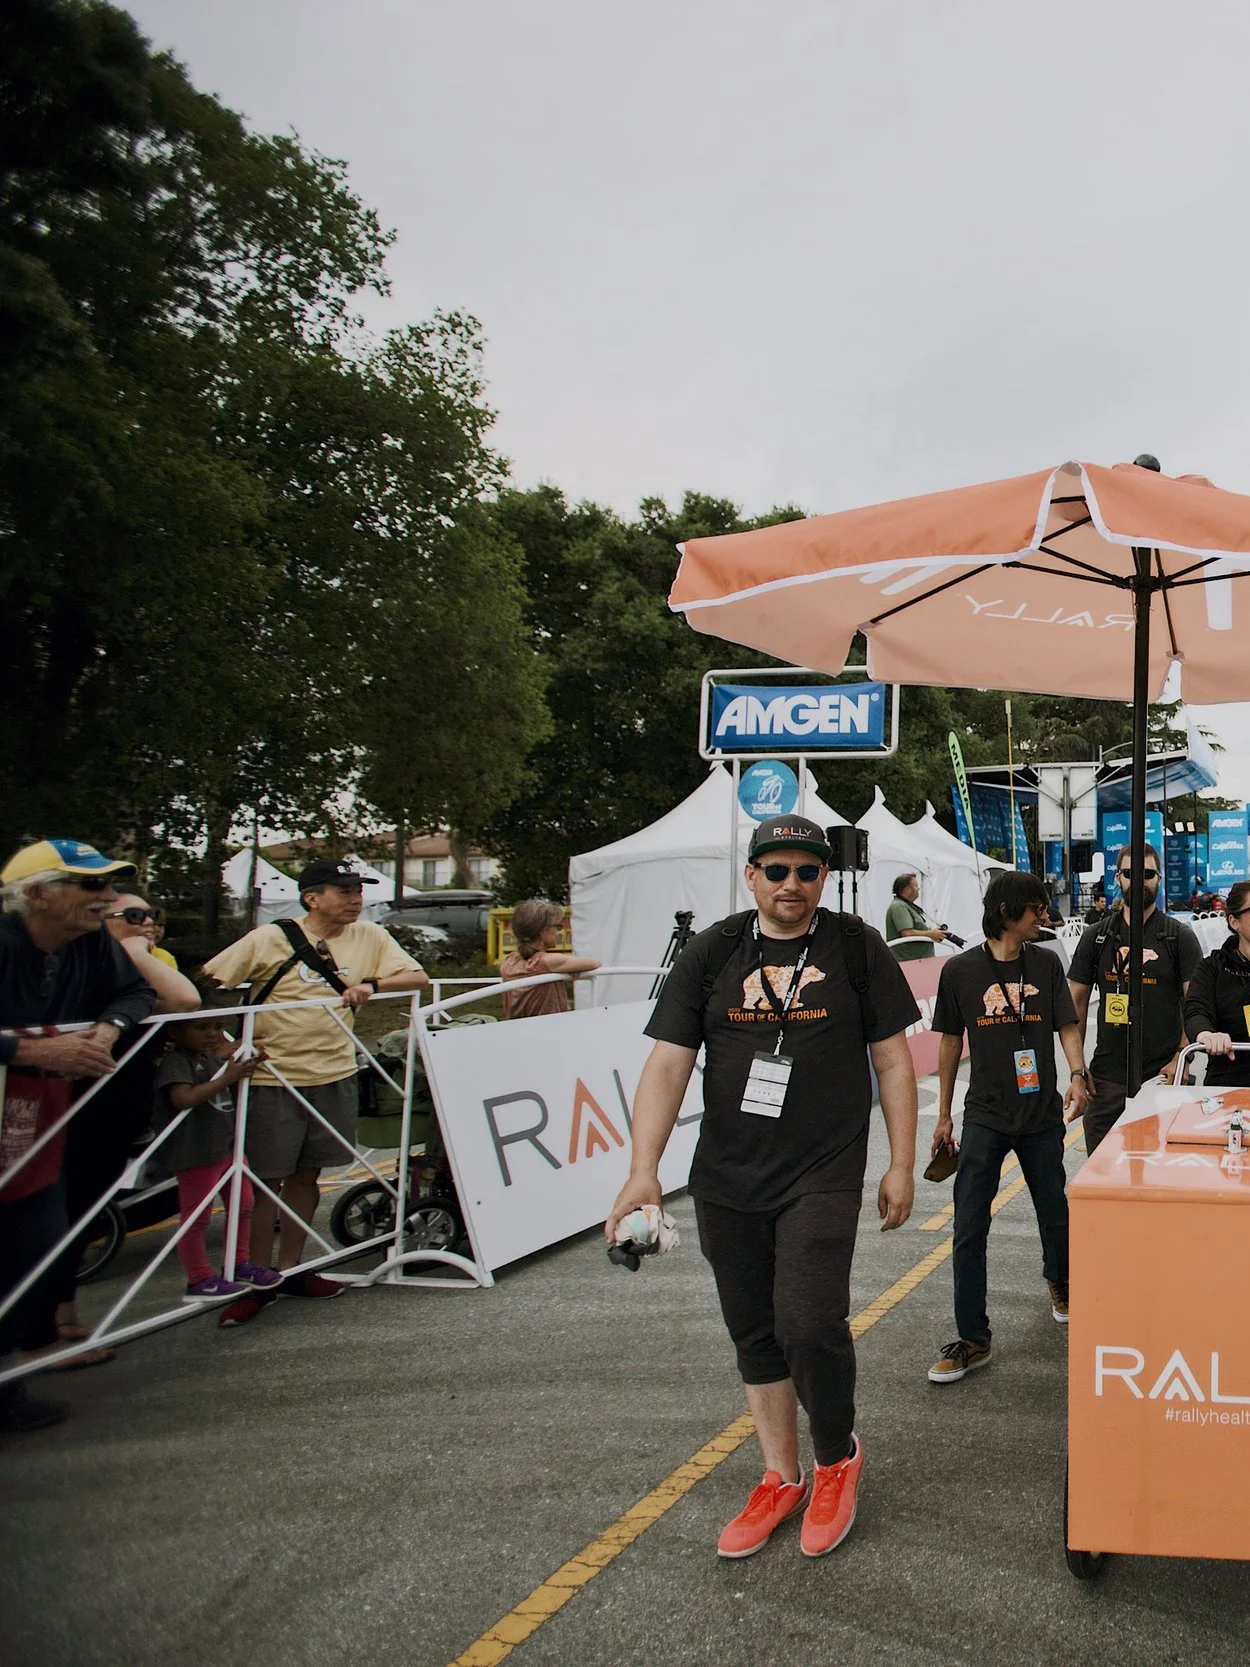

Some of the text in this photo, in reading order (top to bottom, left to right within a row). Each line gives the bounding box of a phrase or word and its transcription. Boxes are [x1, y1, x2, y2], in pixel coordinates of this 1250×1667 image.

[715, 693, 870, 736] AMGEN
[950, 743, 970, 811] MEDIA
[773, 826, 812, 837] RALLY
[728, 1013, 755, 1021] TOUR
[977, 1018, 994, 1026] TOUR
